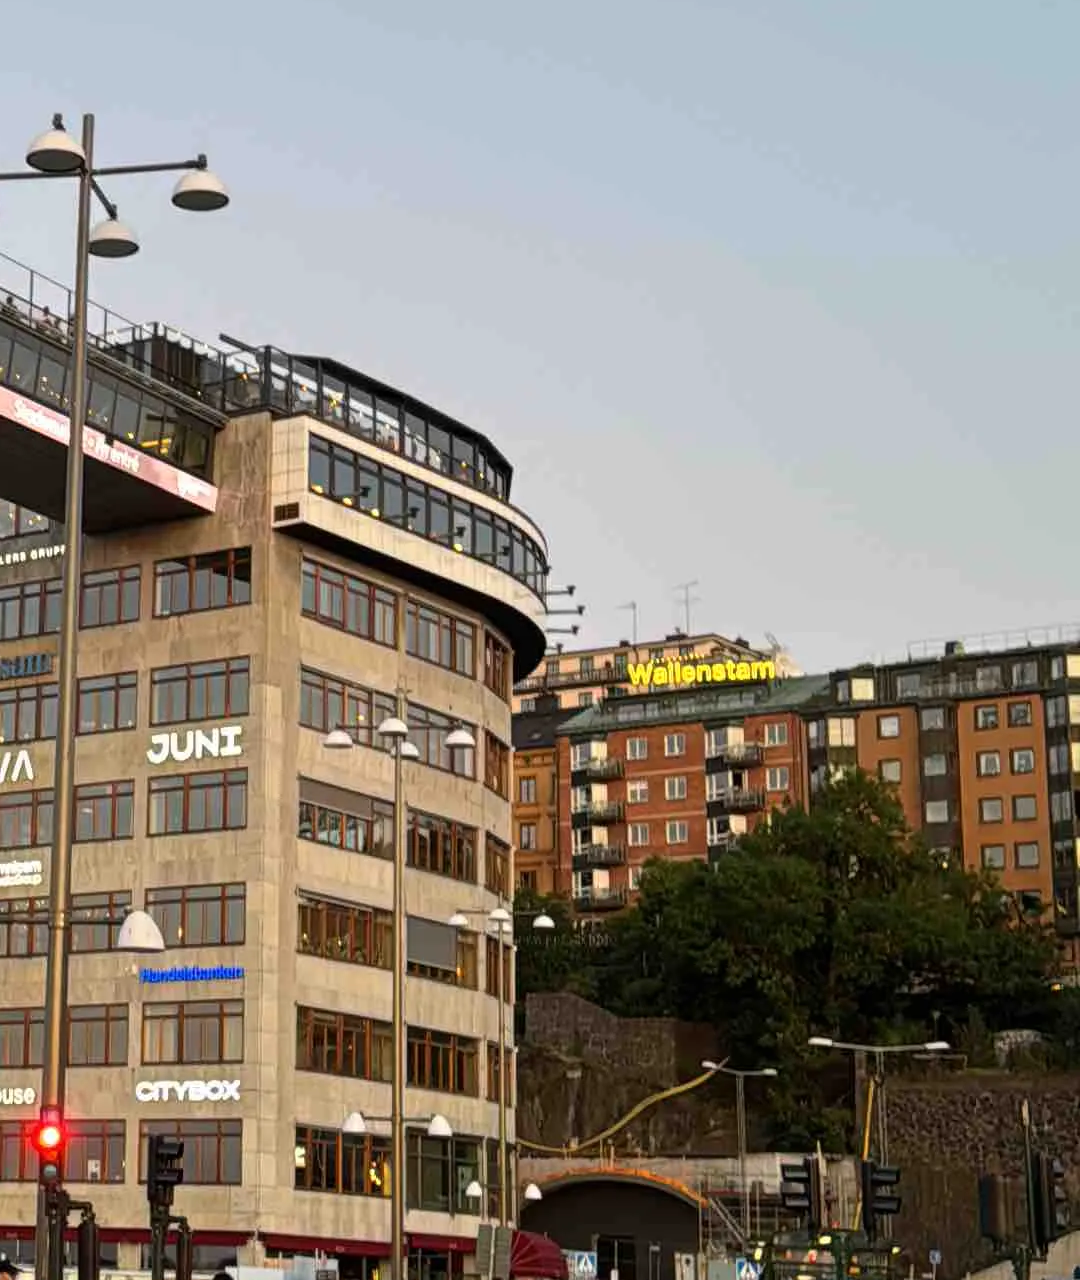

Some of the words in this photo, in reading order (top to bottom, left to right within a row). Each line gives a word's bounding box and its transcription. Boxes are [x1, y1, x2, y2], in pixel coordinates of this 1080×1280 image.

[627, 660, 776, 686] Wallenstam
[146, 726, 242, 764] JUNI
[135, 1079, 241, 1102] CITYBOX
